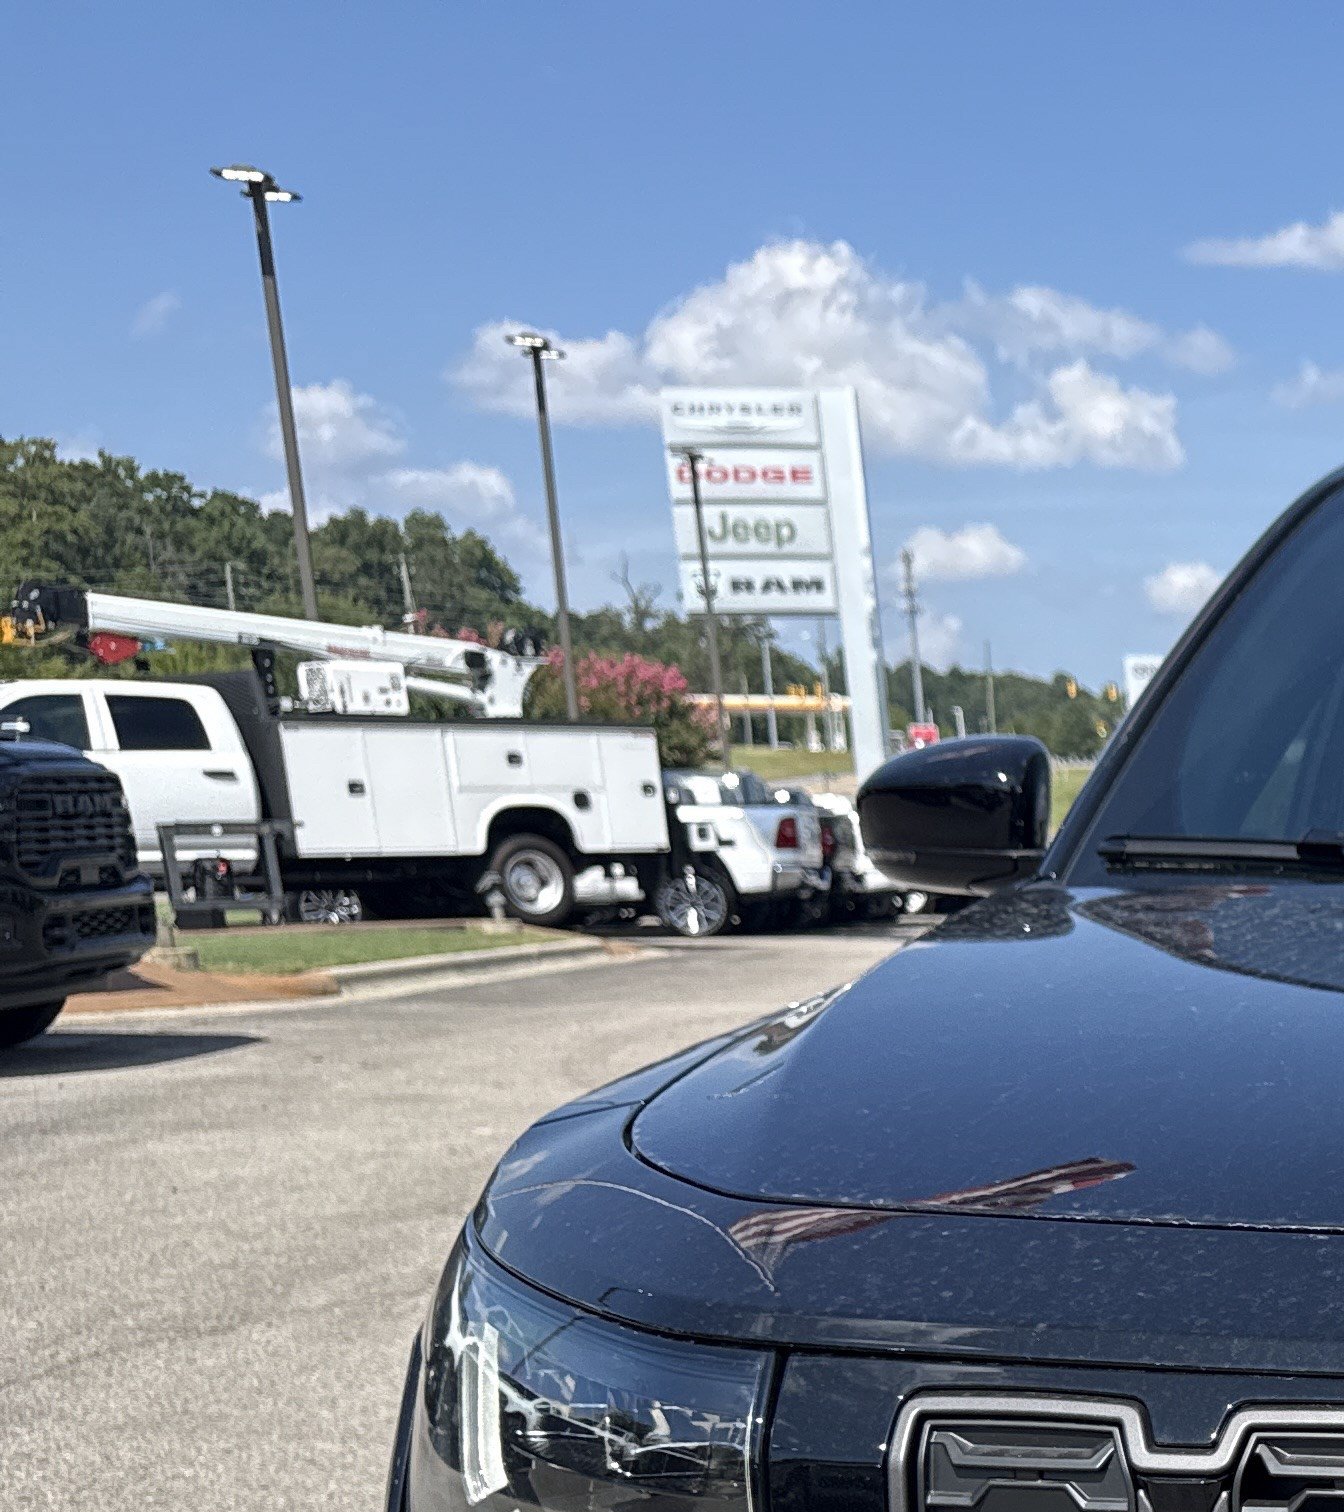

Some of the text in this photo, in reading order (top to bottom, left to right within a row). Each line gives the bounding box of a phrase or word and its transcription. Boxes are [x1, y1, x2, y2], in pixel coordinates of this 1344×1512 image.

[676, 463, 813, 485] DODGE
[708, 510, 797, 549] Jeep
[730, 575, 825, 594] RAM
